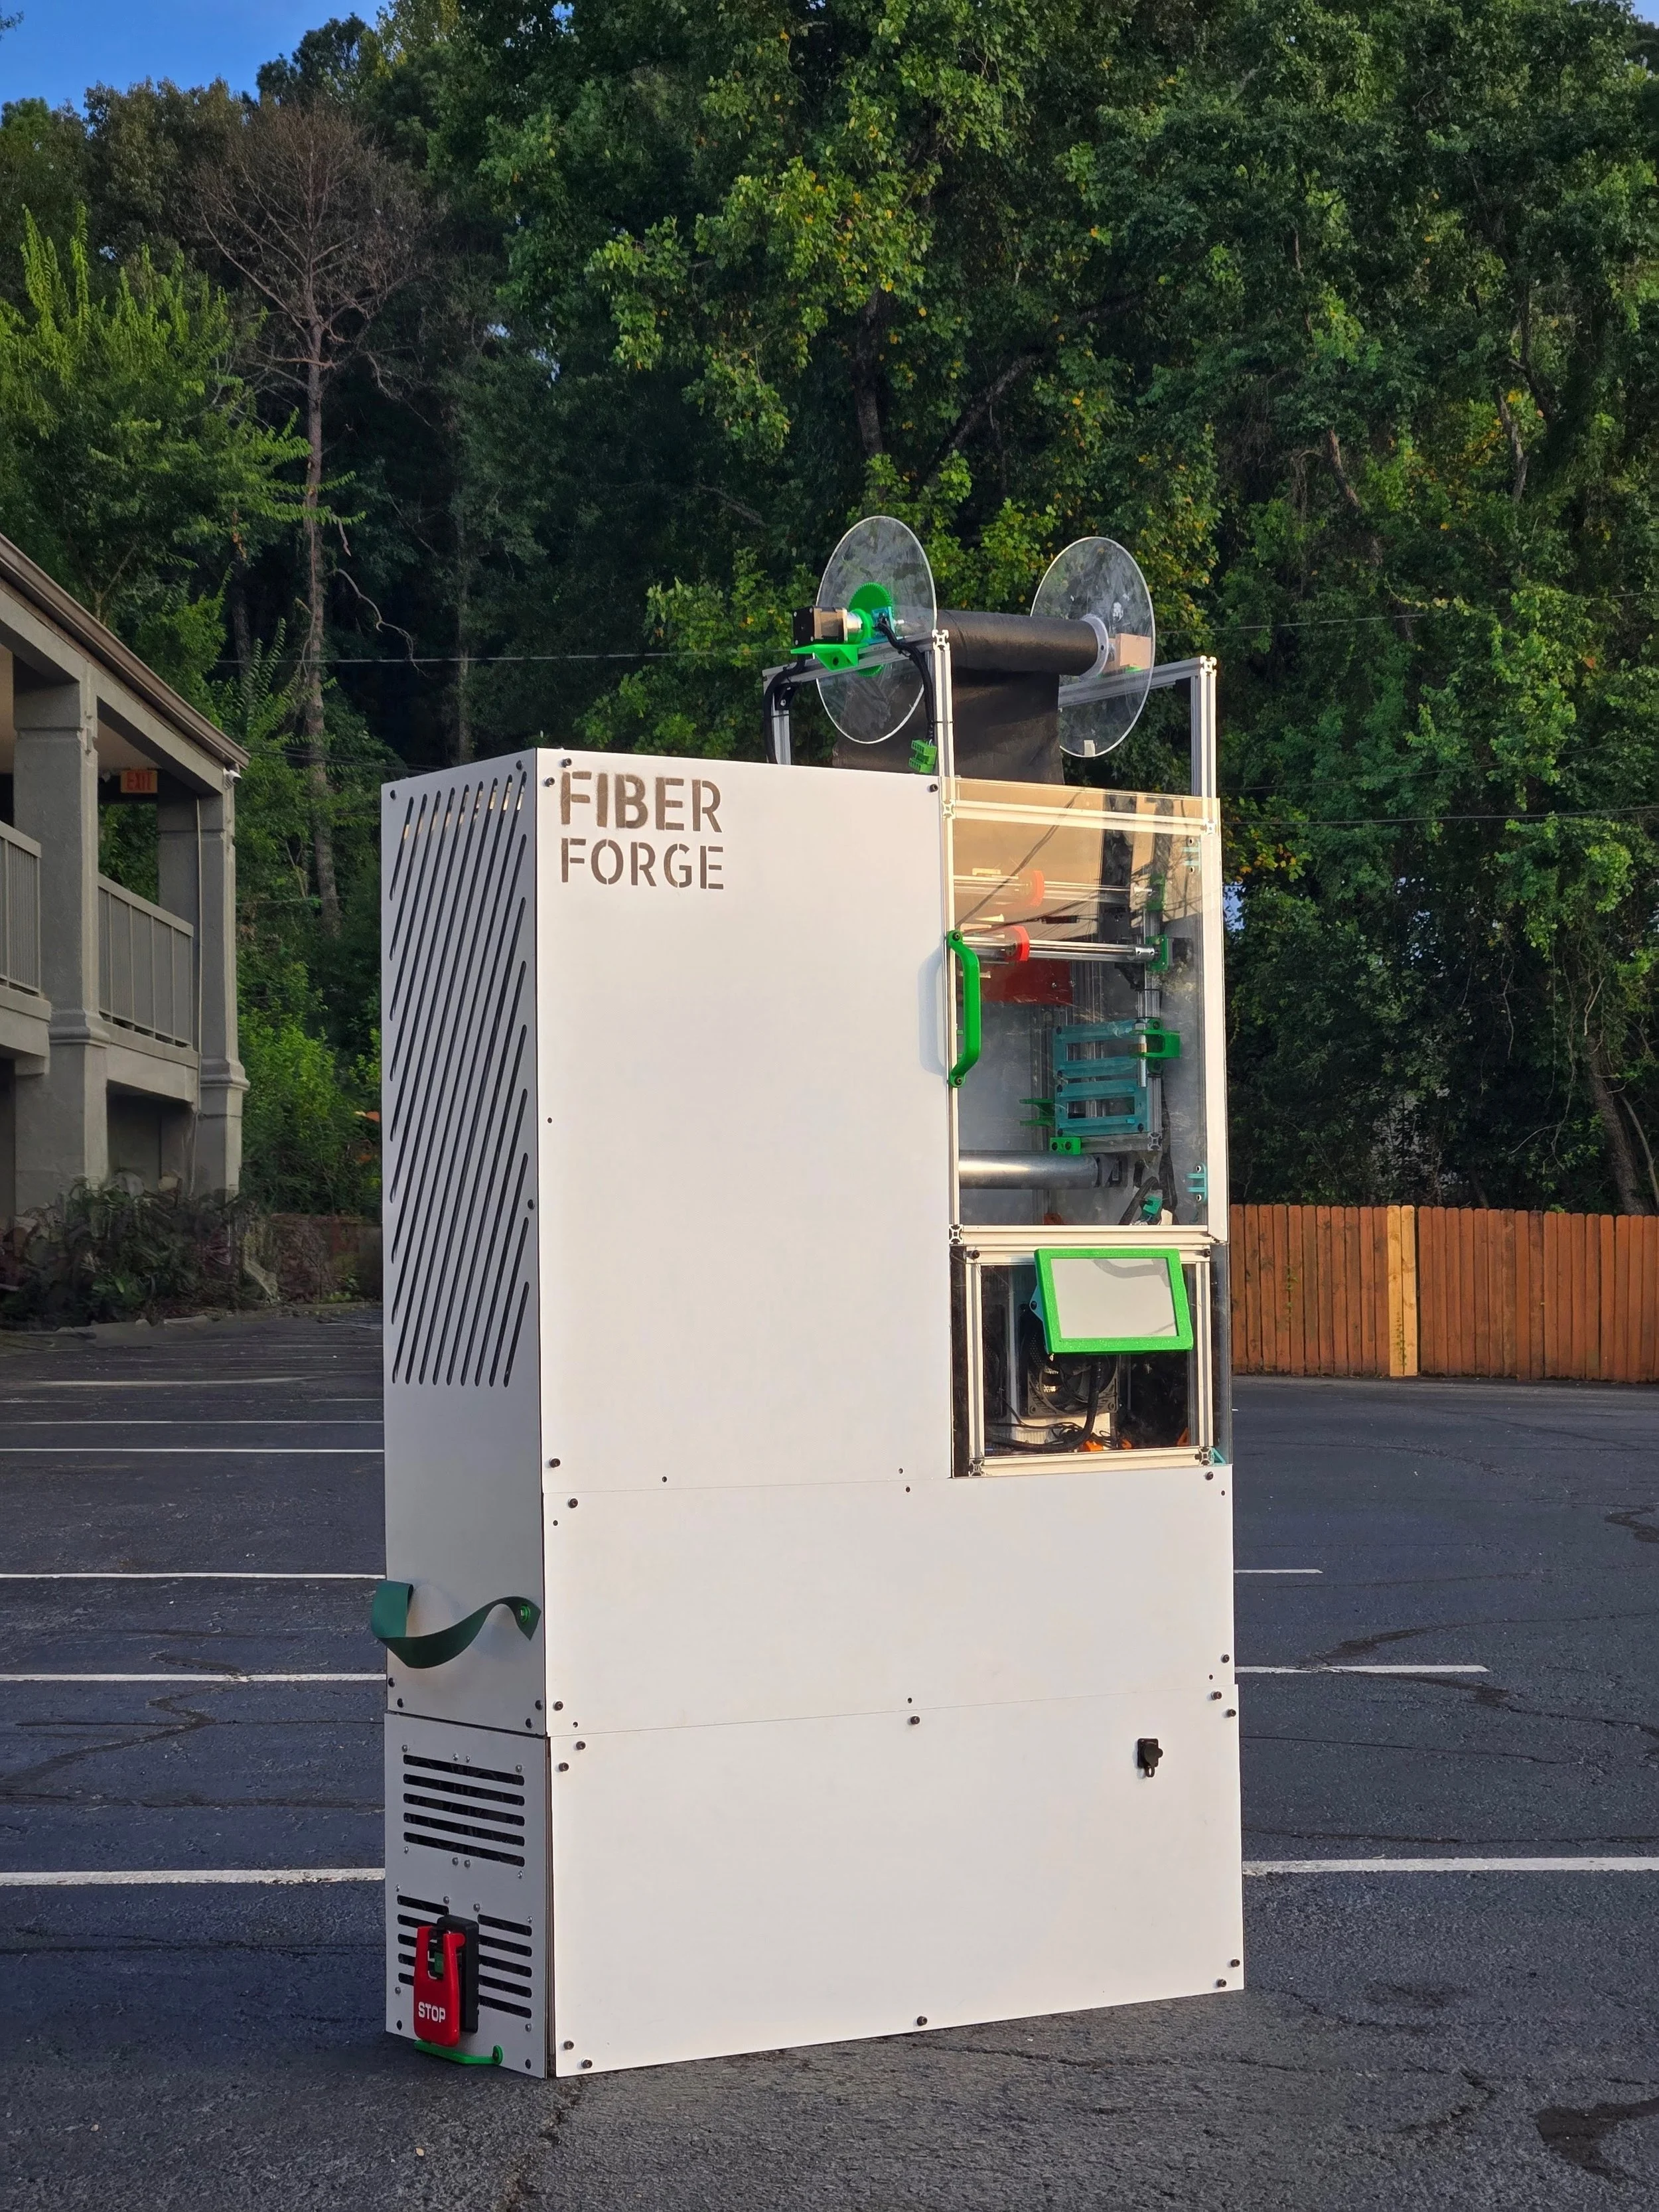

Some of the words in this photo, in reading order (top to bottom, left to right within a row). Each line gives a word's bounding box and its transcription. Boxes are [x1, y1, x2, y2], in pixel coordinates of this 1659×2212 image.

[126, 772, 152, 790] EXIT
[560, 771, 722, 832] FIBER
[561, 838, 724, 889] FORGE
[418, 2002, 446, 2023] STOP
